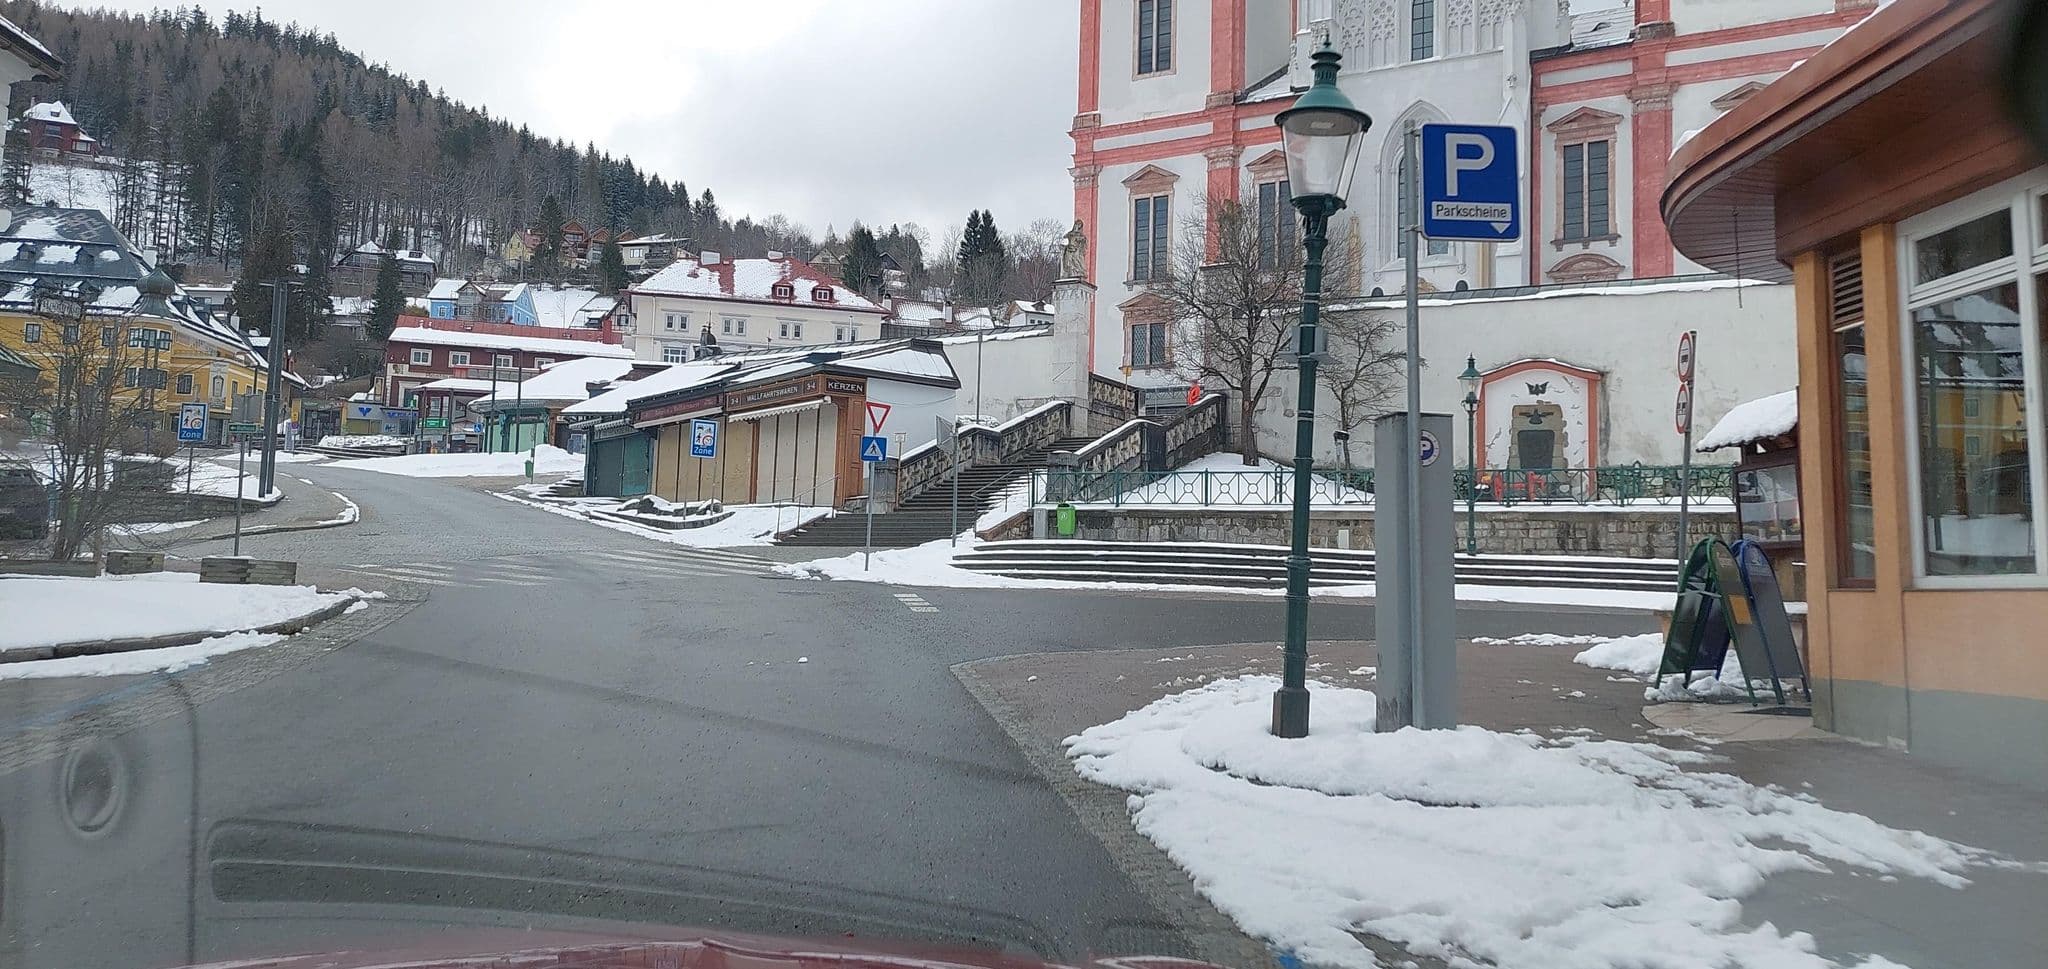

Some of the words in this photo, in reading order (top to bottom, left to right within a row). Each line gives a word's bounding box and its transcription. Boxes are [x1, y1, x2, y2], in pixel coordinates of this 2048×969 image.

[1445, 132, 1495, 197] P
[1435, 204, 1507, 218] Parkscheine
[746, 385, 799, 402] WALLFAHRTSWAREN
[806, 382, 816, 390] 3-4
[827, 381, 863, 393] KERZEN
[180, 430, 202, 439] Zone
[693, 446, 713, 455] Zone
